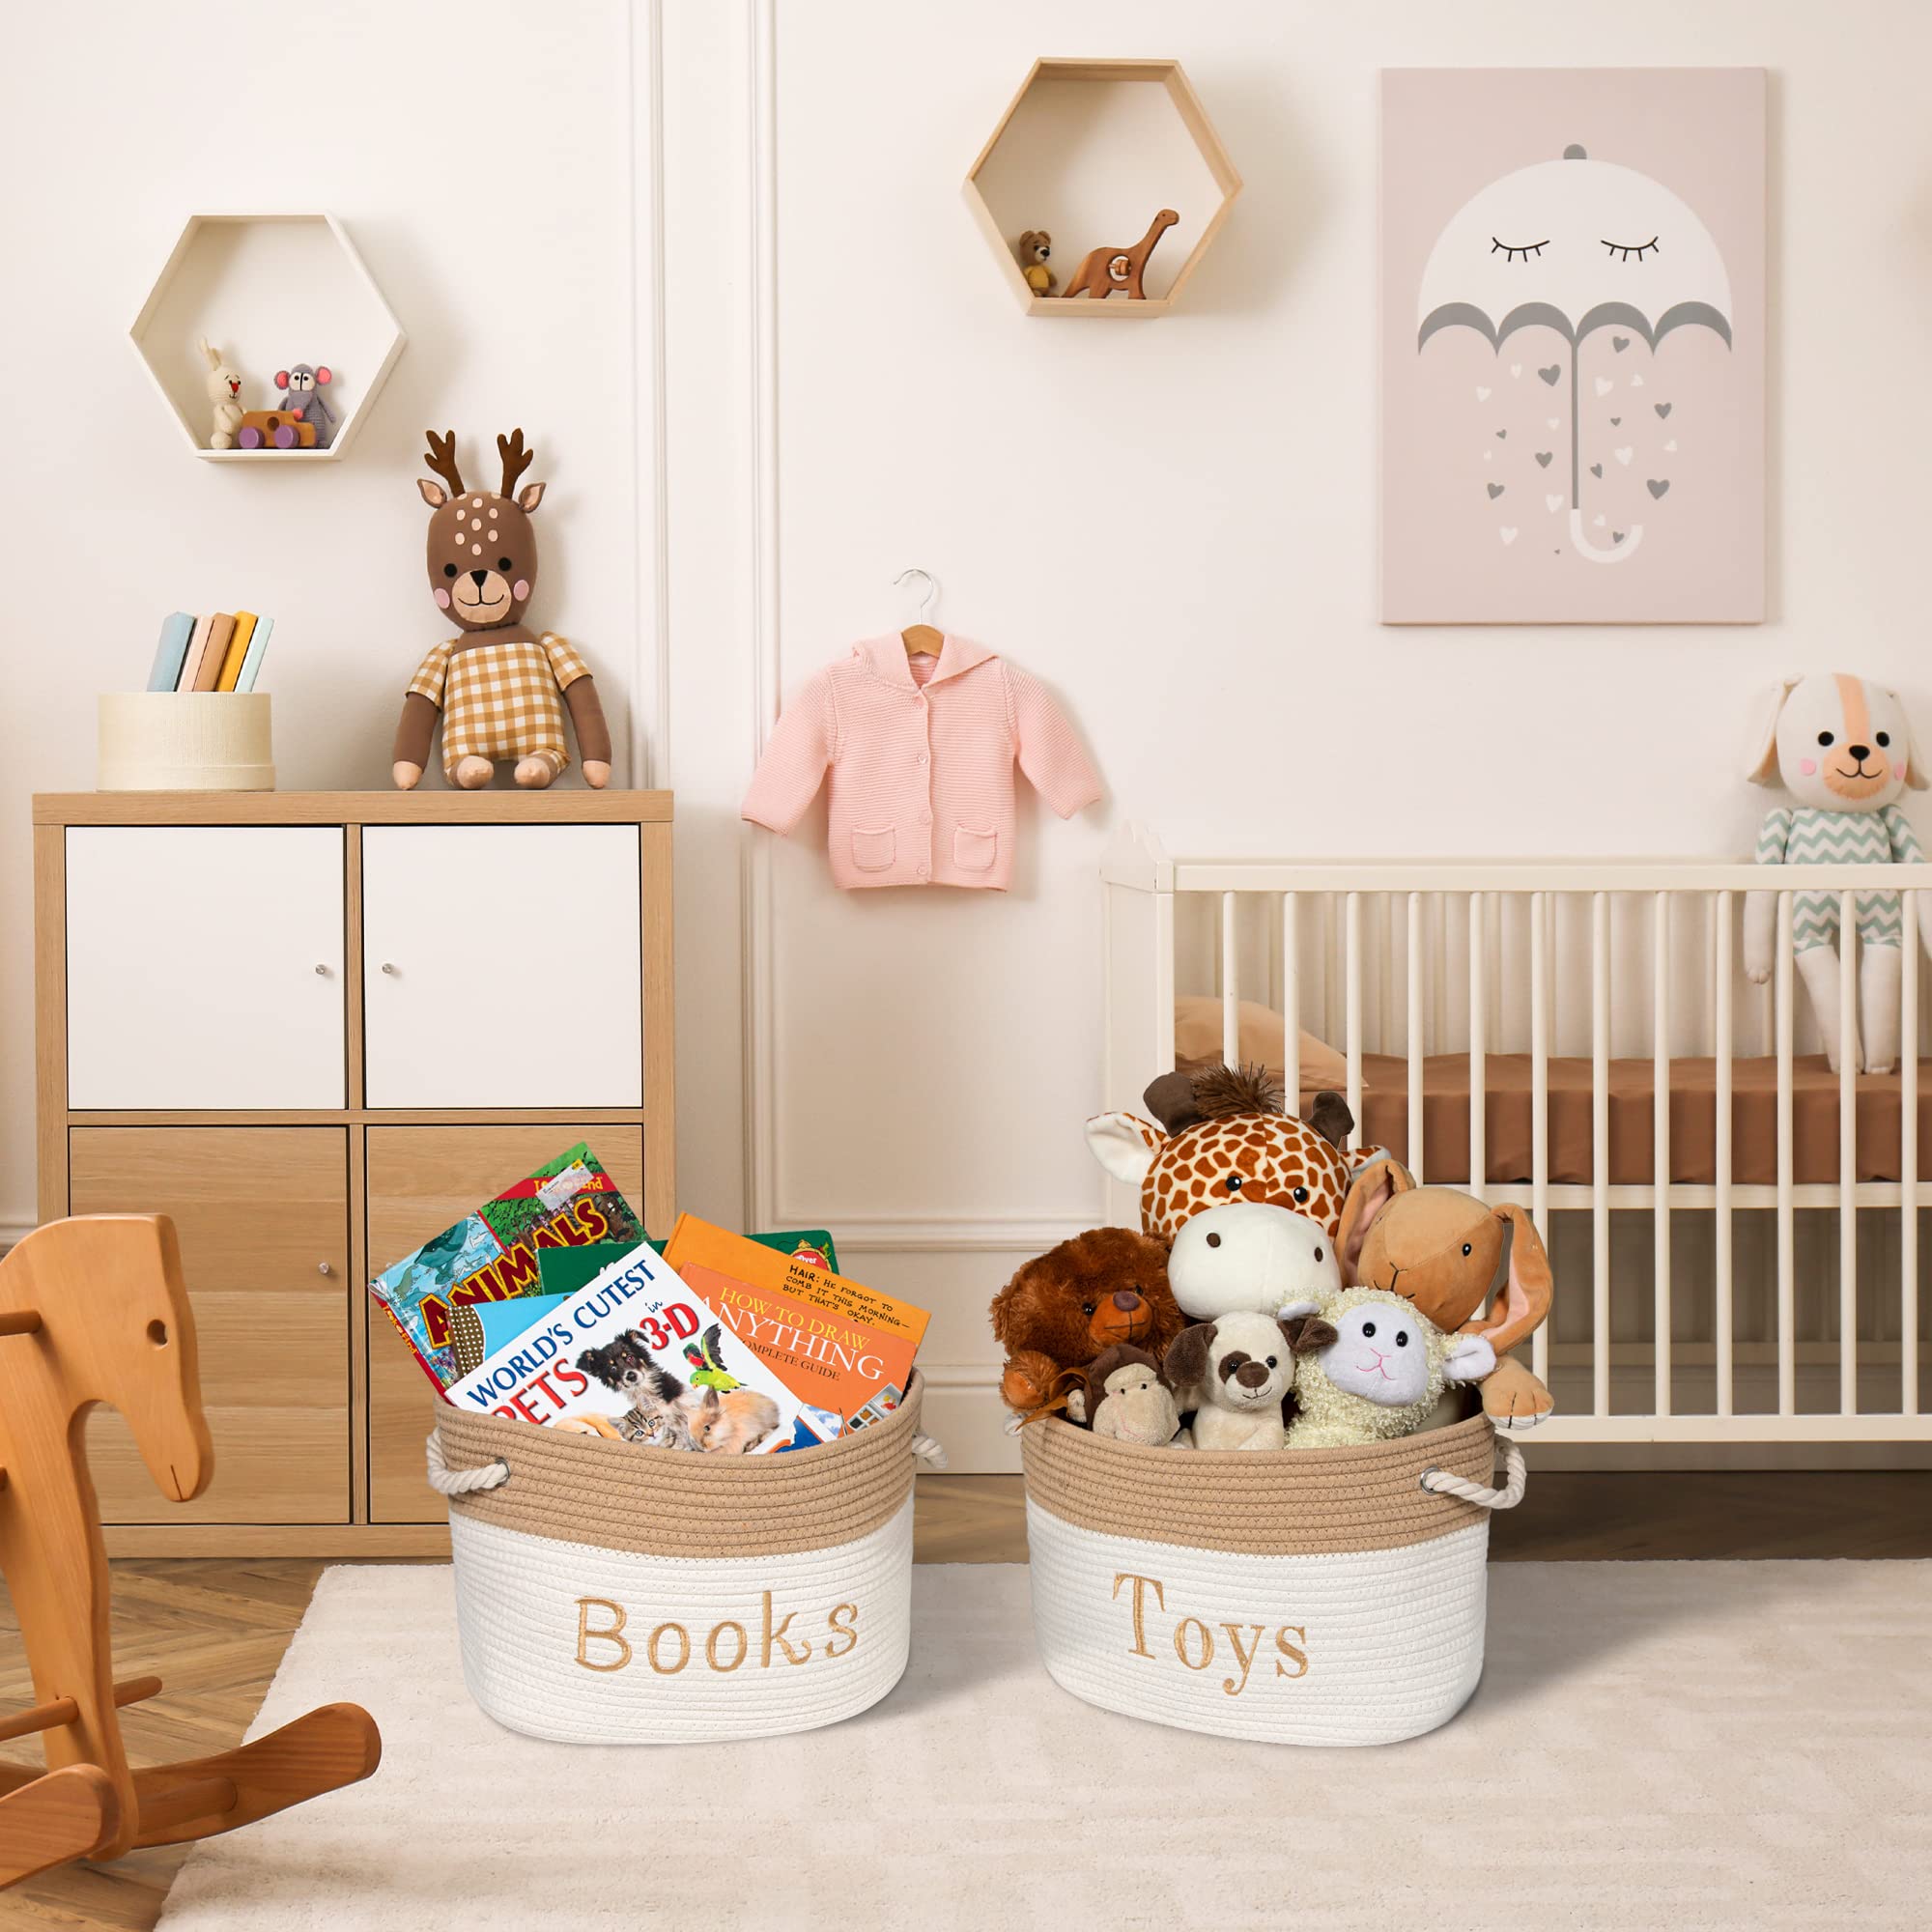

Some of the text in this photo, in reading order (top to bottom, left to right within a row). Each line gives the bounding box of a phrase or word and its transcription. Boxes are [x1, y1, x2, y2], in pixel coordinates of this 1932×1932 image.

[418, 1197, 609, 1350] ANIMALS
[782, 1284, 804, 1296] BUT
[809, 1293, 839, 1311] THAT'S
[785, 1275, 812, 1290] COMB
[816, 1287, 829, 1296] IT
[833, 1293, 853, 1307] THIS
[789, 1264, 894, 1312] HAIR: HE FORGOT TO
[639, 1302, 699, 1350] 3-D
[644, 1298, 664, 1314] in
[719, 1288, 870, 1350] HOW TO DRAW
[467, 1259, 656, 1407] WORLD'S CUTEST
[740, 1337, 841, 1381] OMPLETE GUIDE
[574, 1590, 859, 1674] Books
[1113, 1573, 1309, 1696] Toys
